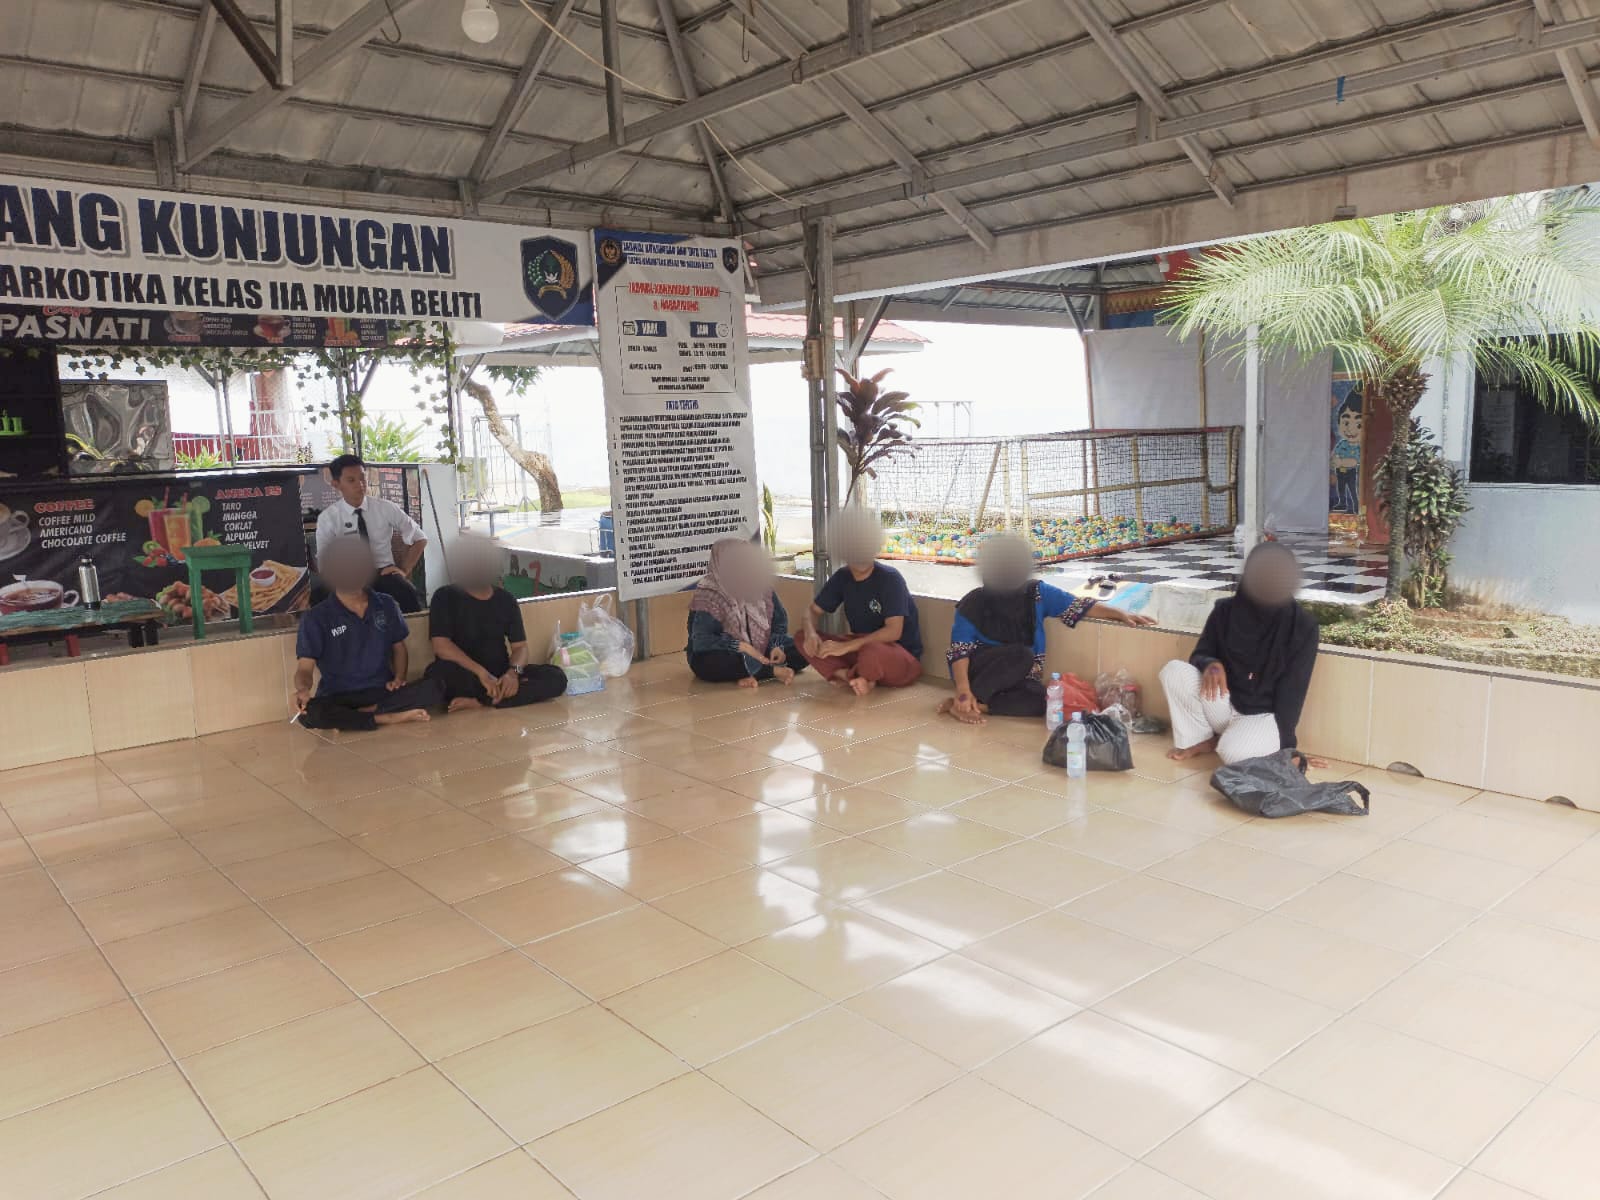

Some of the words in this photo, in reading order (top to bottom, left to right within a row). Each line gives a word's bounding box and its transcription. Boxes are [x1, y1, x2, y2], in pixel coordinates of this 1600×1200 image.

[0, 184, 124, 252] ANG
[137, 197, 451, 275] KUNJUNGAN
[0, 264, 168, 305] ARKOTIKA
[172, 274, 263, 310] KELAS
[269, 280, 309, 311] IIA
[313, 284, 406, 316] MUARA
[411, 288, 482, 318] BELITI
[0, 313, 151, 341] PASNATI
[34, 498, 96, 514] COFFEE
[222, 502, 242, 511] TARO
[38, 515, 71, 527] COFFEE
[73, 512, 96, 524] MILD
[223, 511, 257, 521] MANGGA
[40, 525, 93, 538] AMERICANO
[224, 521, 252, 531] COKLAT
[41, 536, 93, 549] CHOCOLATE
[95, 532, 127, 544] COFFEE
[225, 531, 258, 541] ALPUKAT
